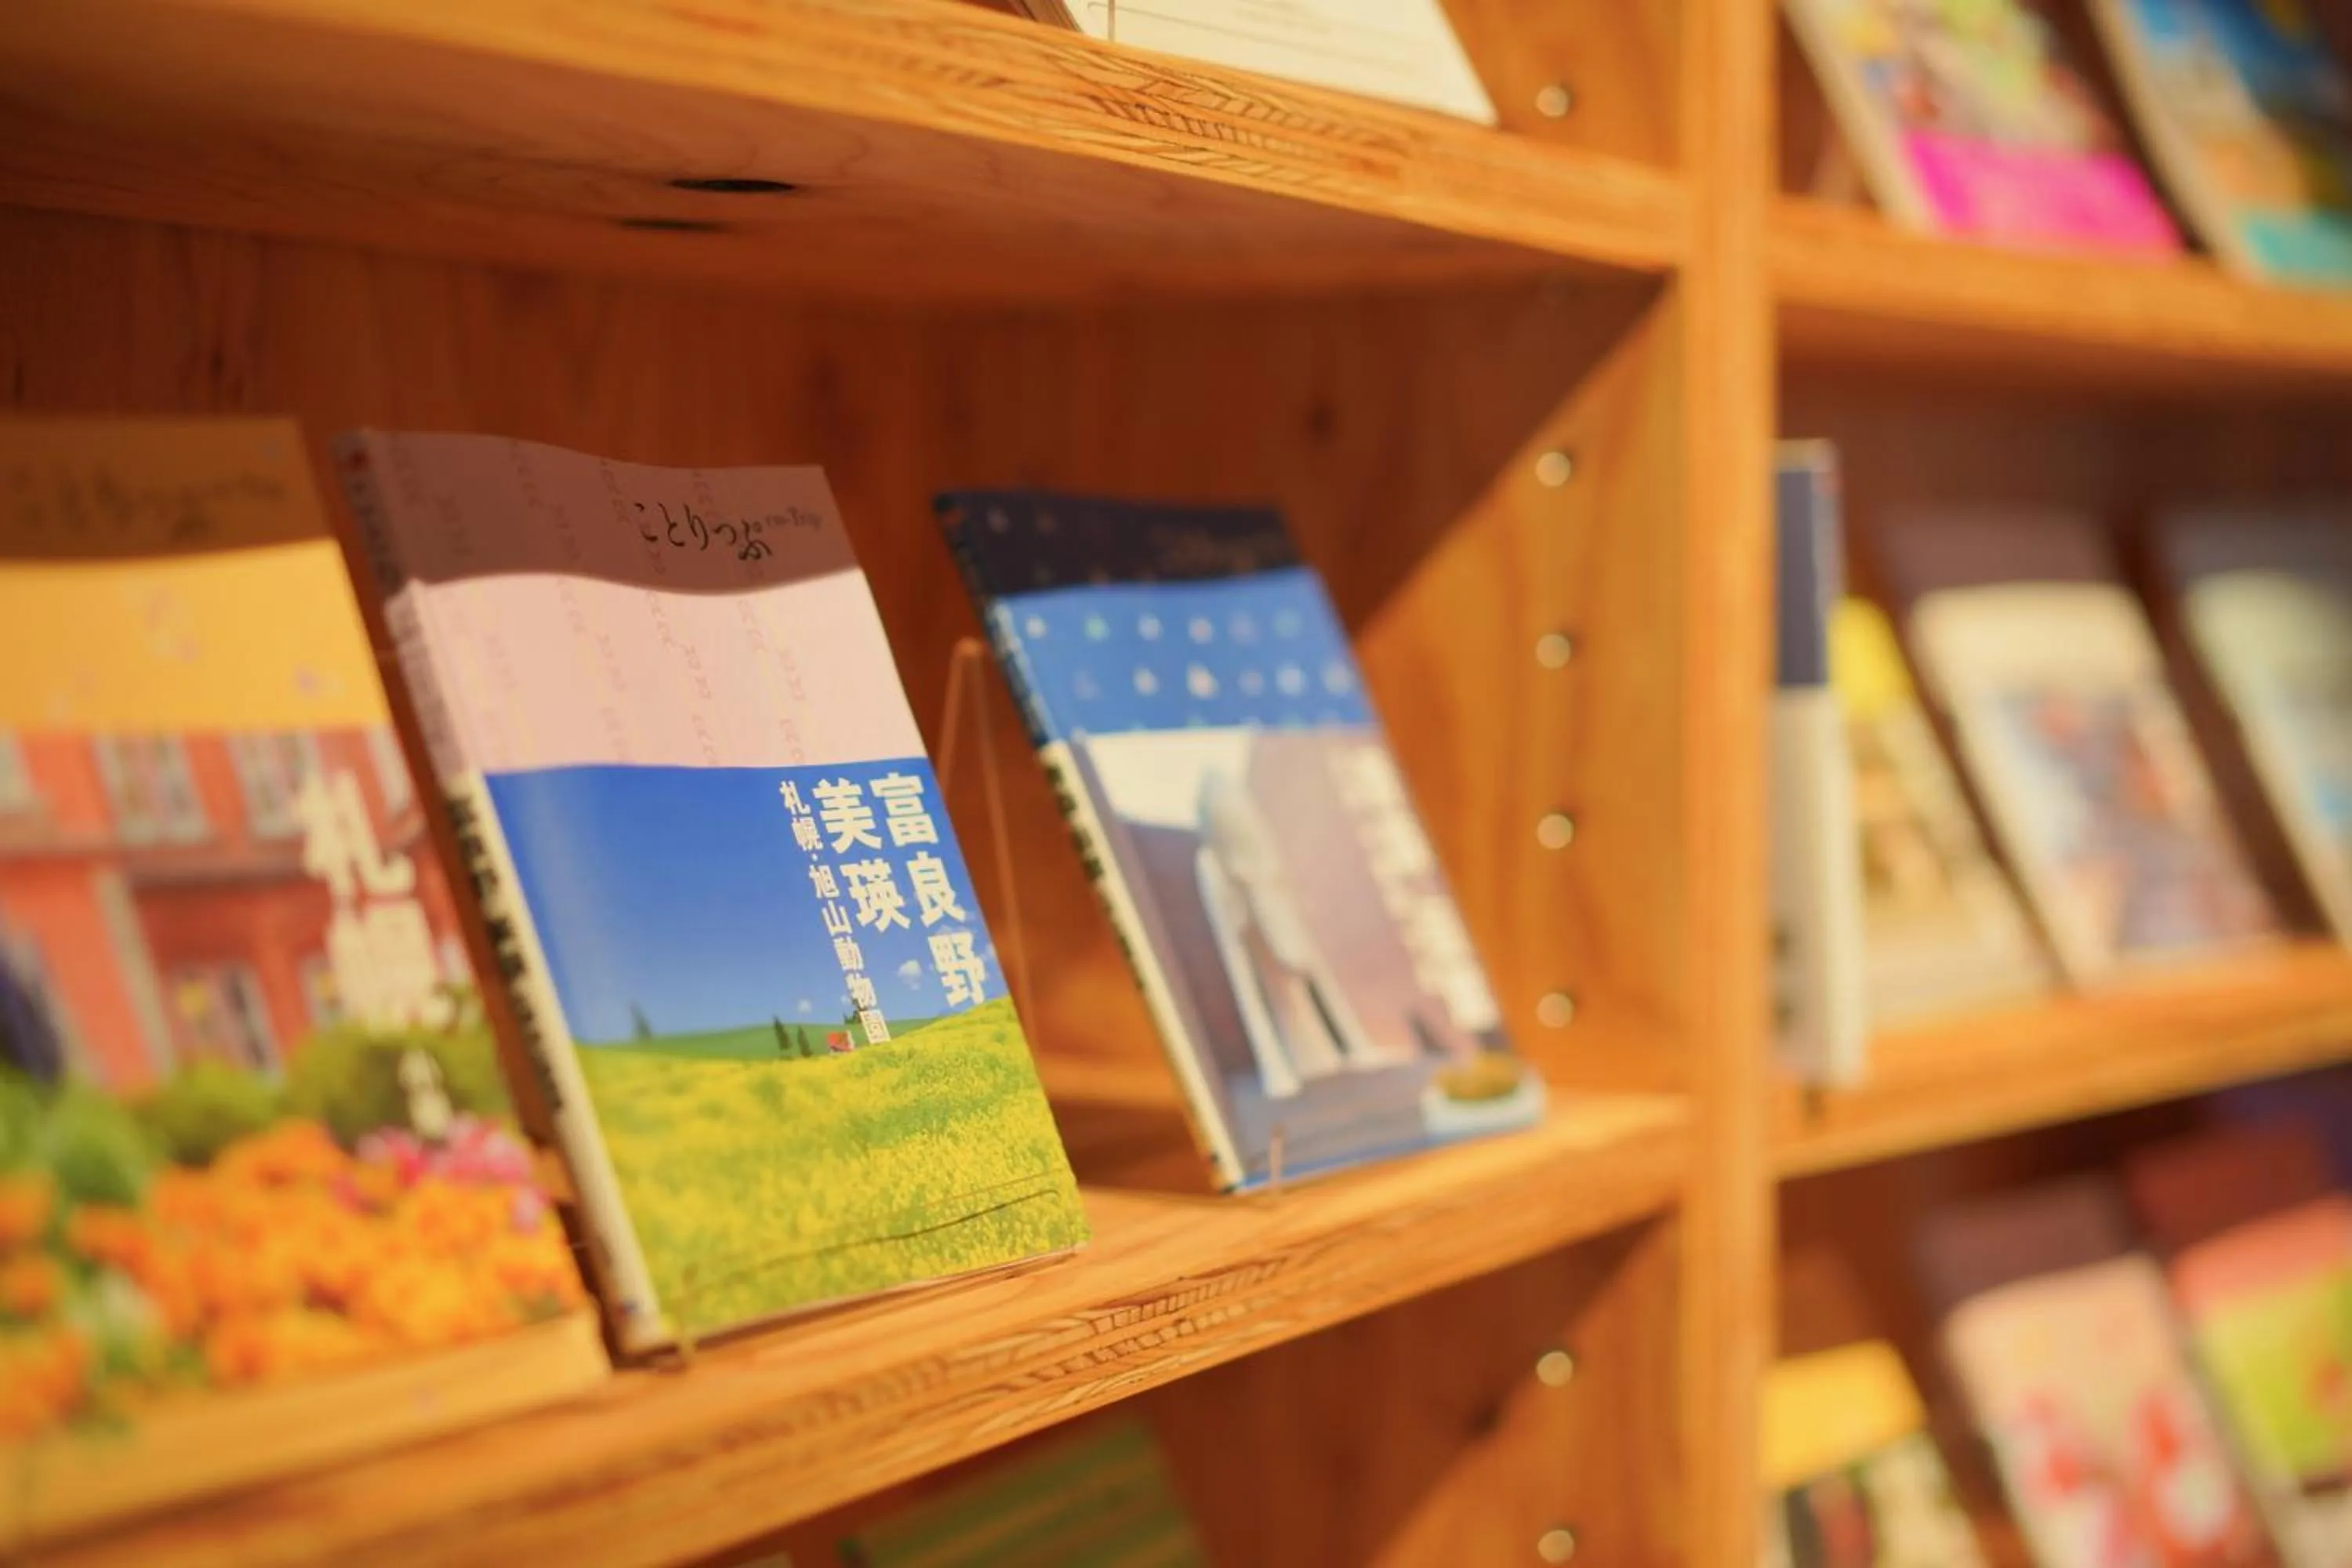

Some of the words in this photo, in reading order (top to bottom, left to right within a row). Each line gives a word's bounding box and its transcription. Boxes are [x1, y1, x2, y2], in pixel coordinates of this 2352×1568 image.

[812, 777, 911, 933] 美瑛
[869, 771, 985, 1007] 富良野
